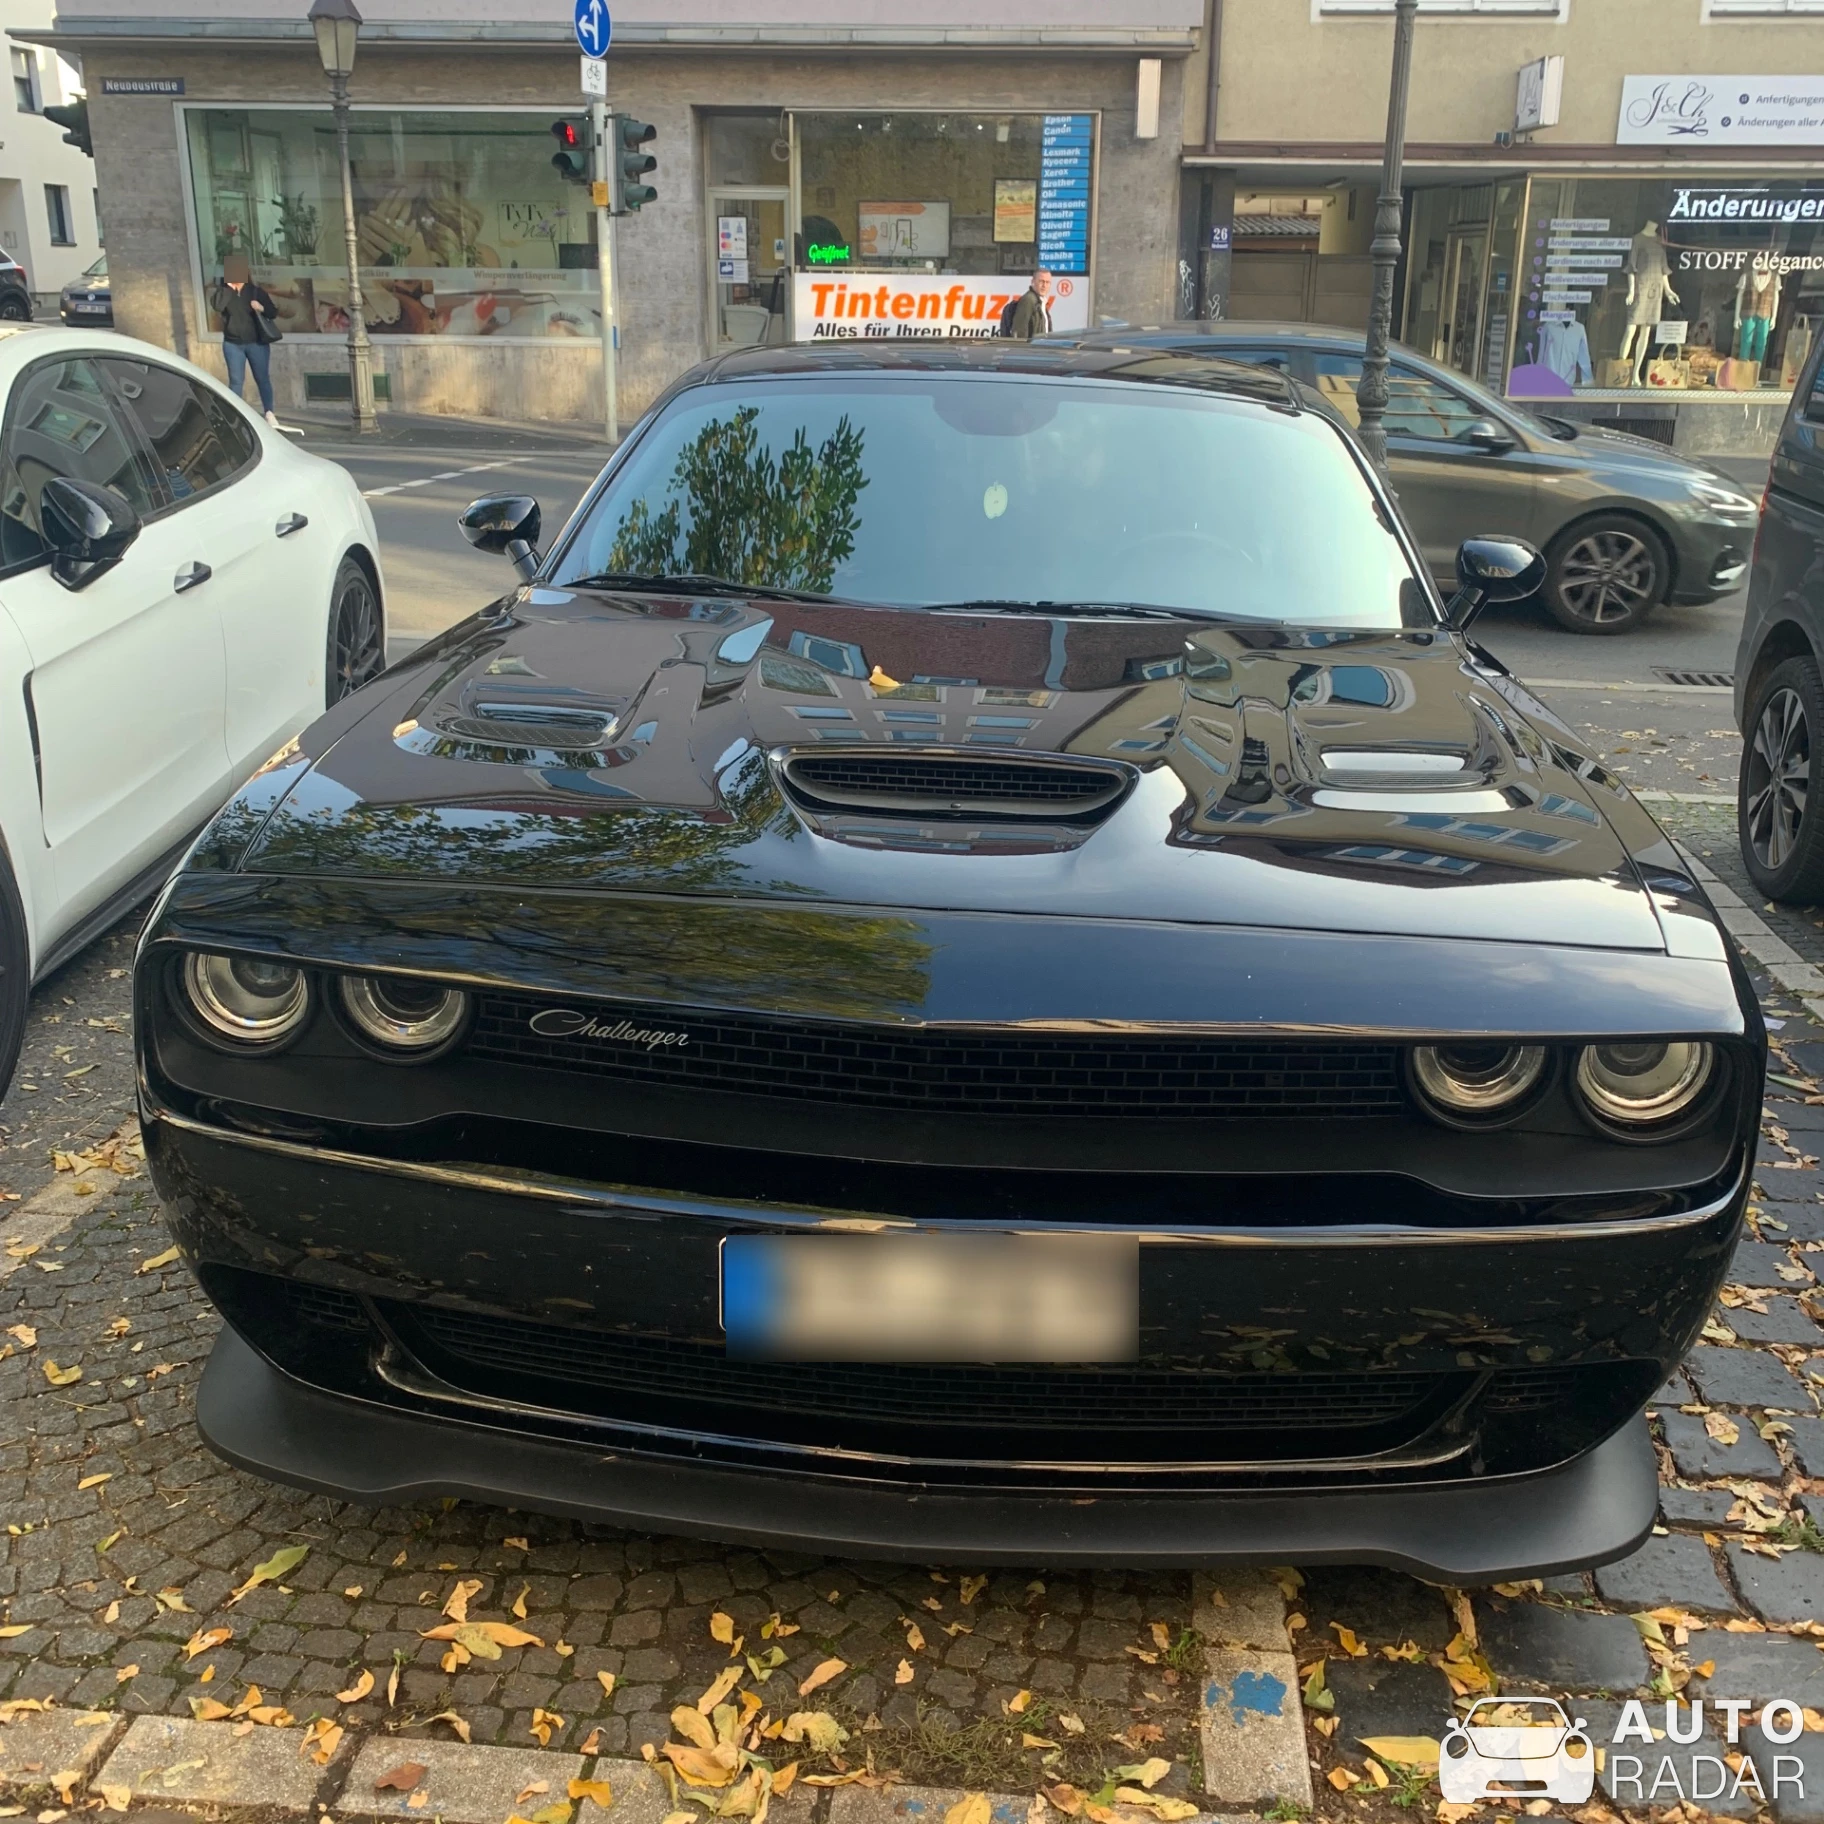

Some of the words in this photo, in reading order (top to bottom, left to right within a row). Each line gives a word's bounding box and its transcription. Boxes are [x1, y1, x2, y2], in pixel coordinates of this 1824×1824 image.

[1045, 116, 1072, 125] Epson
[1738, 115, 1796, 129] Änderungen
[1798, 117, 1818, 127] aller
[1044, 127, 1071, 136] Canon
[1044, 137, 1056, 146] HP
[1043, 148, 1081, 157] Lexmark
[1043, 158, 1078, 167] Kyocera
[1044, 169, 1068, 177] Xerox
[1043, 179, 1075, 188] Brother
[1042, 189, 1056, 198] Oki
[1041, 200, 1087, 209] Panasonic
[1041, 210, 1074, 219] Minolta
[1041, 221, 1073, 230] Olivetti
[1551, 219, 1608, 230] Anfertigungen
[1041, 231, 1071, 240] Sagem
[1213, 227, 1228, 241] 26
[1041, 241, 1065, 250] Ricoh
[1550, 238, 1597, 249] Änderungen
[1598, 239, 1615, 247] aller
[809, 244, 849, 264] Geöffnet
[1040, 252, 1074, 261] Toshiba
[1679, 251, 1747, 270] STOFF
[1752, 251, 1824, 275] éléganc
[474, 270, 567, 281] Wimpernverlängerung
[811, 284, 1056, 321] Tintenfuz
[813, 323, 858, 337] Alles
[864, 323, 890, 337] für
[896, 324, 942, 337] Ihren
[529, 1009, 689, 1051] Challenger
